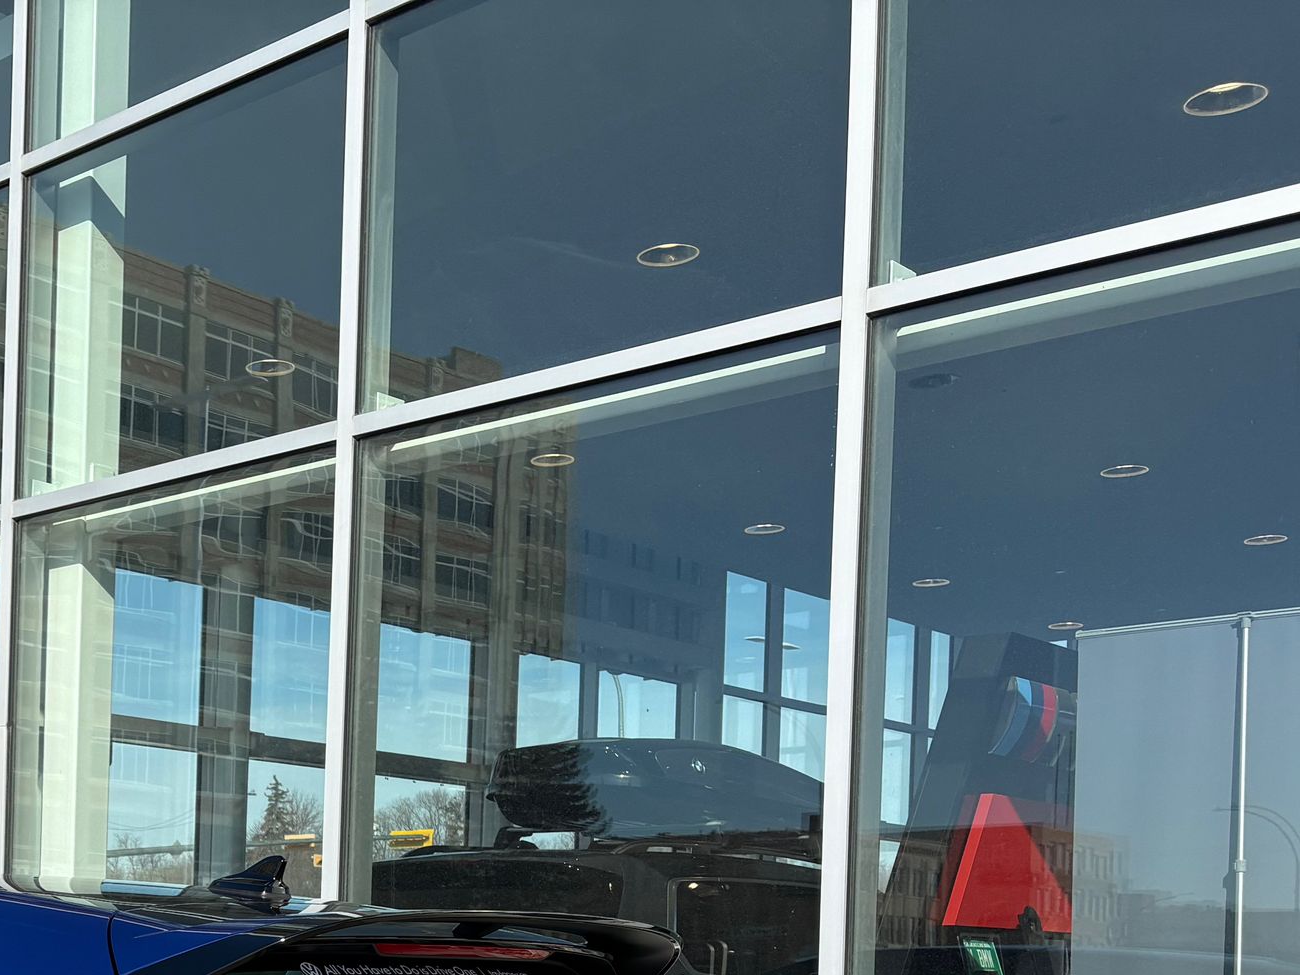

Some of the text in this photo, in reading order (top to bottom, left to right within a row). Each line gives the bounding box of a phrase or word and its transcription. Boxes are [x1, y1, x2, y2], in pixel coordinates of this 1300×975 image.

[324, 964, 341, 975] All
[341, 964, 360, 975] You
[359, 964, 391, 975] Have
[392, 965, 402, 975] to
[400, 964, 419, 975] Do
[417, 965, 429, 975] is
[425, 965, 455, 975] Drive
